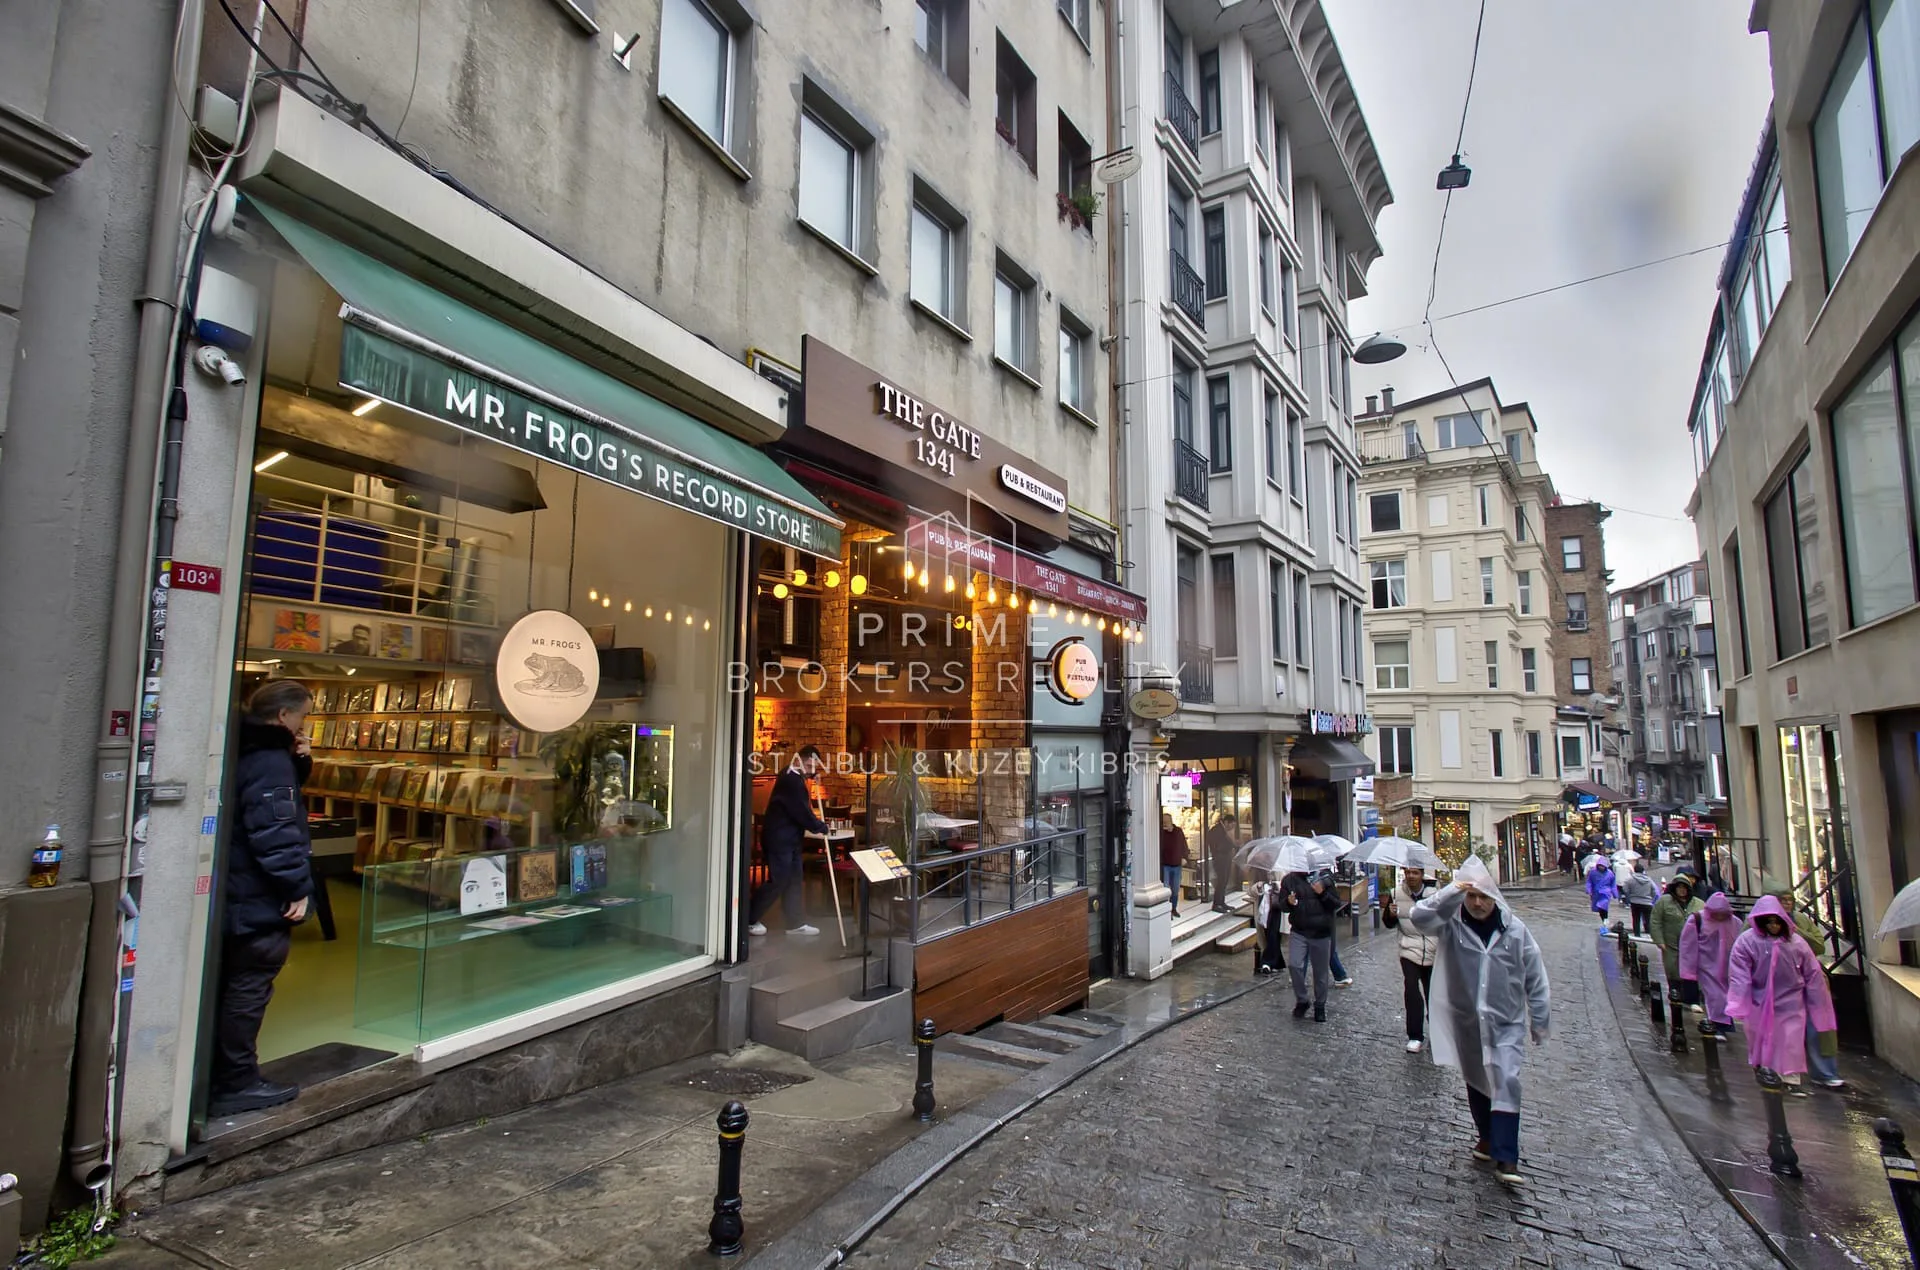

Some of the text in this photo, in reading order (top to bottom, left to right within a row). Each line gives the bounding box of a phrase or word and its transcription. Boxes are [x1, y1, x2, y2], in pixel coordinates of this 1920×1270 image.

[879, 382, 982, 460] THE GATE
[446, 379, 812, 545] MR. FROG'S RECORD STORE
[917, 437, 955, 477] 1341
[1005, 470, 1019, 485] PUB
[1025, 480, 1064, 508] RESTAURANT
[929, 531, 945, 545] PUB
[954, 539, 996, 564] RESTAURANT
[1035, 565, 1067, 585] THE GATE
[1045, 581, 1059, 593] 1341
[531, 637, 582, 650] MR. FROG'S
